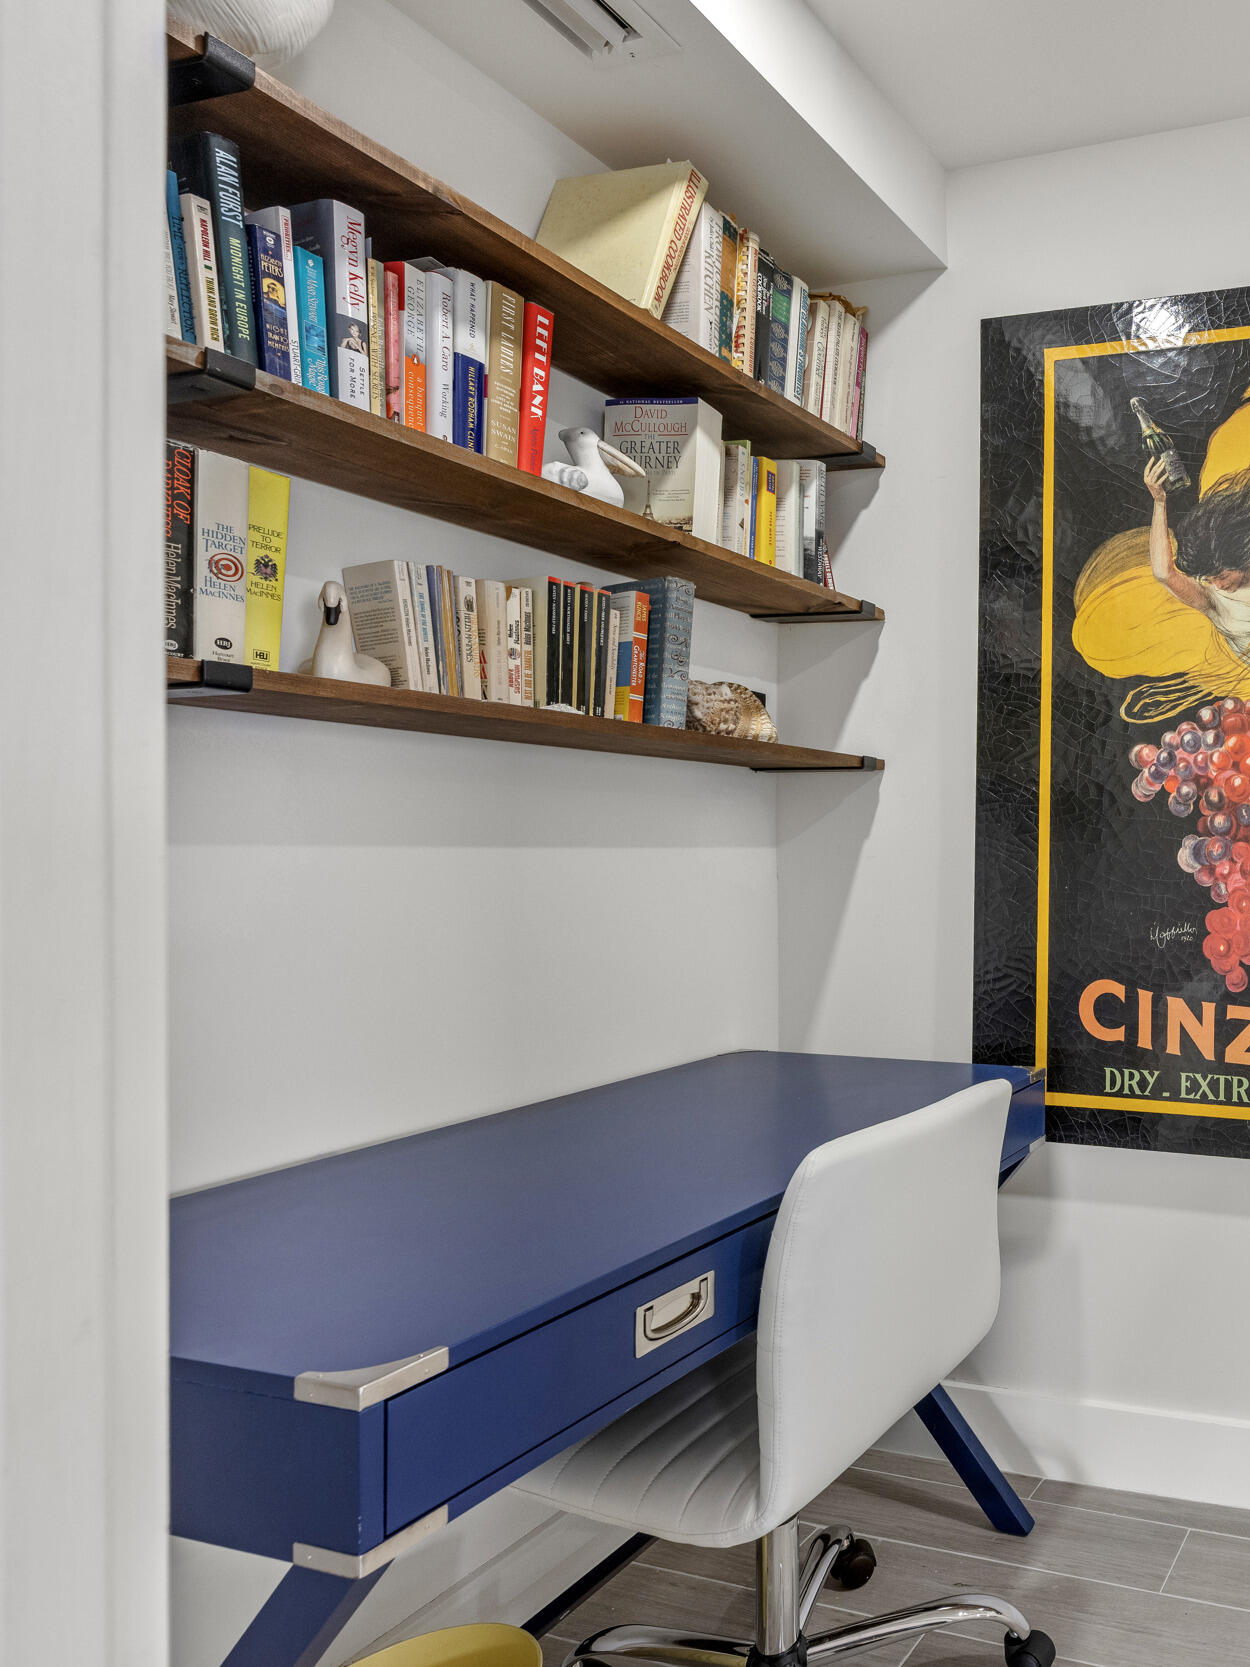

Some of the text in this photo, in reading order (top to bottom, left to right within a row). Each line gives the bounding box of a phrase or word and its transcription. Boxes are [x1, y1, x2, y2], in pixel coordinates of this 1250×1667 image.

[215, 148, 243, 228] ALAN FURST
[673, 169, 703, 242] ILLUSTRATED
[199, 218, 212, 262] NAPOLEON HILL
[261, 261, 283, 277] PETERS
[340, 216, 367, 312] Megyn Kelly
[654, 233, 682, 305] COOKBOOK
[206, 277, 216, 295] THINK
[229, 237, 250, 341] MIDNIGHT IN EUROPE
[704, 250, 714, 314] KITCHEN
[208, 308, 218, 325] GROW
[407, 285, 415, 337] GEORGE
[416, 279, 424, 353] ELIZABETH
[210, 326, 220, 342] RICH
[441, 292, 451, 372] Robert A. Caro
[500, 293, 515, 375] FIRST LADIES
[348, 356, 357, 400] FOR MORE
[530, 314, 550, 422] LEFT BANK
[415, 386, 424, 426] banquet
[440, 383, 450, 418] Working
[634, 406, 668, 419] DAVID
[491, 420, 516, 434] SUSAN
[491, 428, 516, 442] SWAIN
[614, 420, 687, 433] McCULLOUGH
[619, 440, 681, 454] GREATER
[630, 455, 681, 469] URNEY
[174, 449, 191, 524] CLOAK OF
[201, 528, 247, 546] HIDDEN
[216, 522, 233, 534] THE
[248, 524, 283, 539] PRELUDE
[260, 535, 272, 543] TO
[201, 538, 245, 554] TARGET
[250, 540, 281, 554] TERROR
[167, 543, 182, 629] Helen MacInnes
[204, 576, 236, 592] HELEN
[250, 580, 277, 592] HELEN
[464, 612, 472, 633] HELEN
[631, 645, 639, 687] GRANTCHESTER
[1103, 1067, 1161, 1097] DRY
